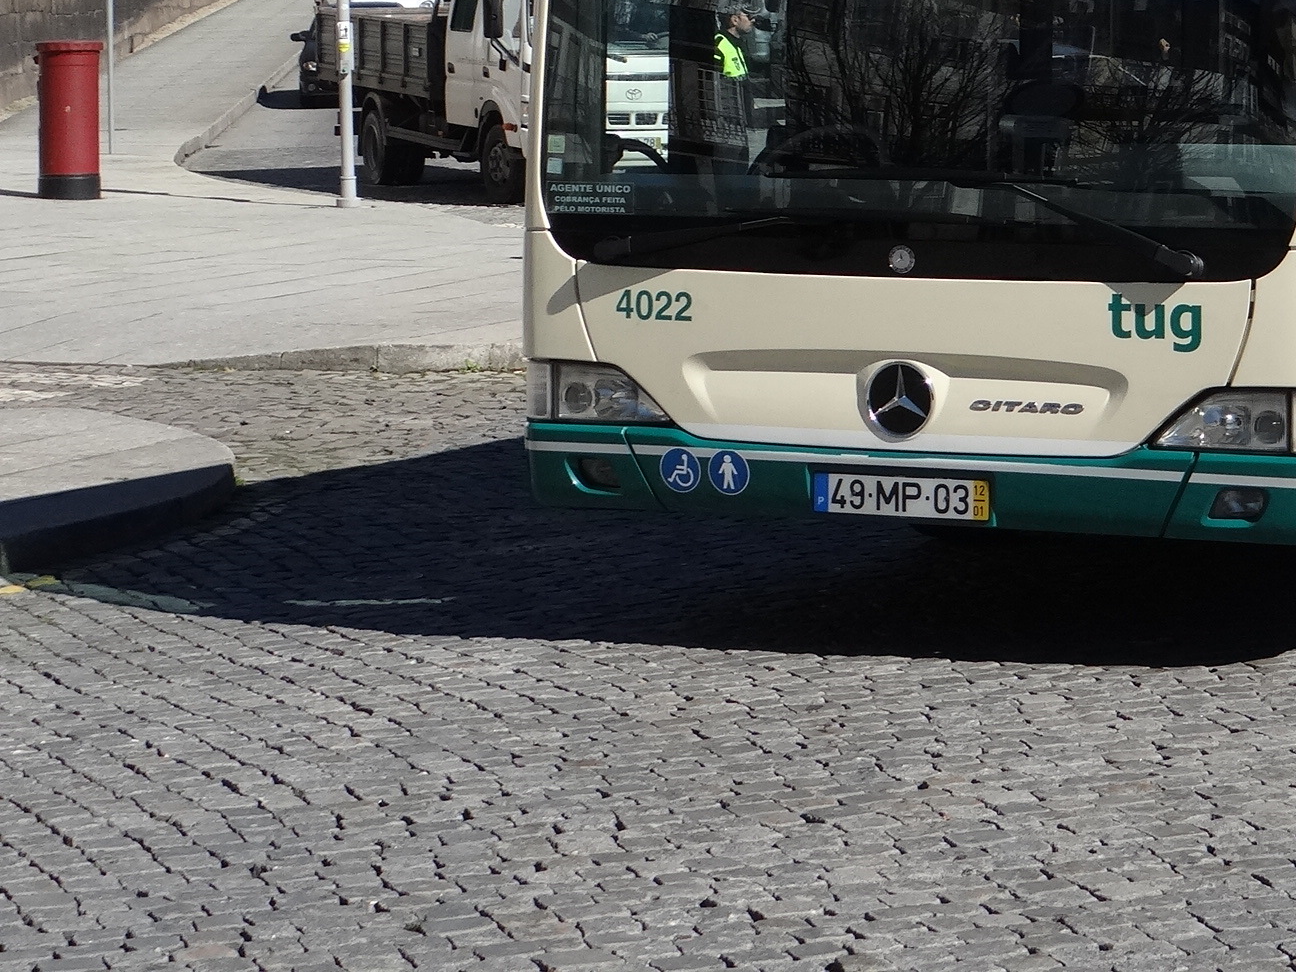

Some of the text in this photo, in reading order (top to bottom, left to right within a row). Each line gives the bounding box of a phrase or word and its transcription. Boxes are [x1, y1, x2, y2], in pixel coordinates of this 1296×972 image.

[549, 184, 594, 193] AGENTE
[554, 195, 627, 205] COBRANÇA FEITA
[554, 205, 626, 214] PELO MOTORISTA
[616, 289, 693, 322] 4022
[1108, 292, 1203, 353] tug
[969, 399, 1085, 416] CITARO
[817, 496, 825, 505] P
[973, 484, 985, 497] 12
[973, 504, 984, 517] 01
